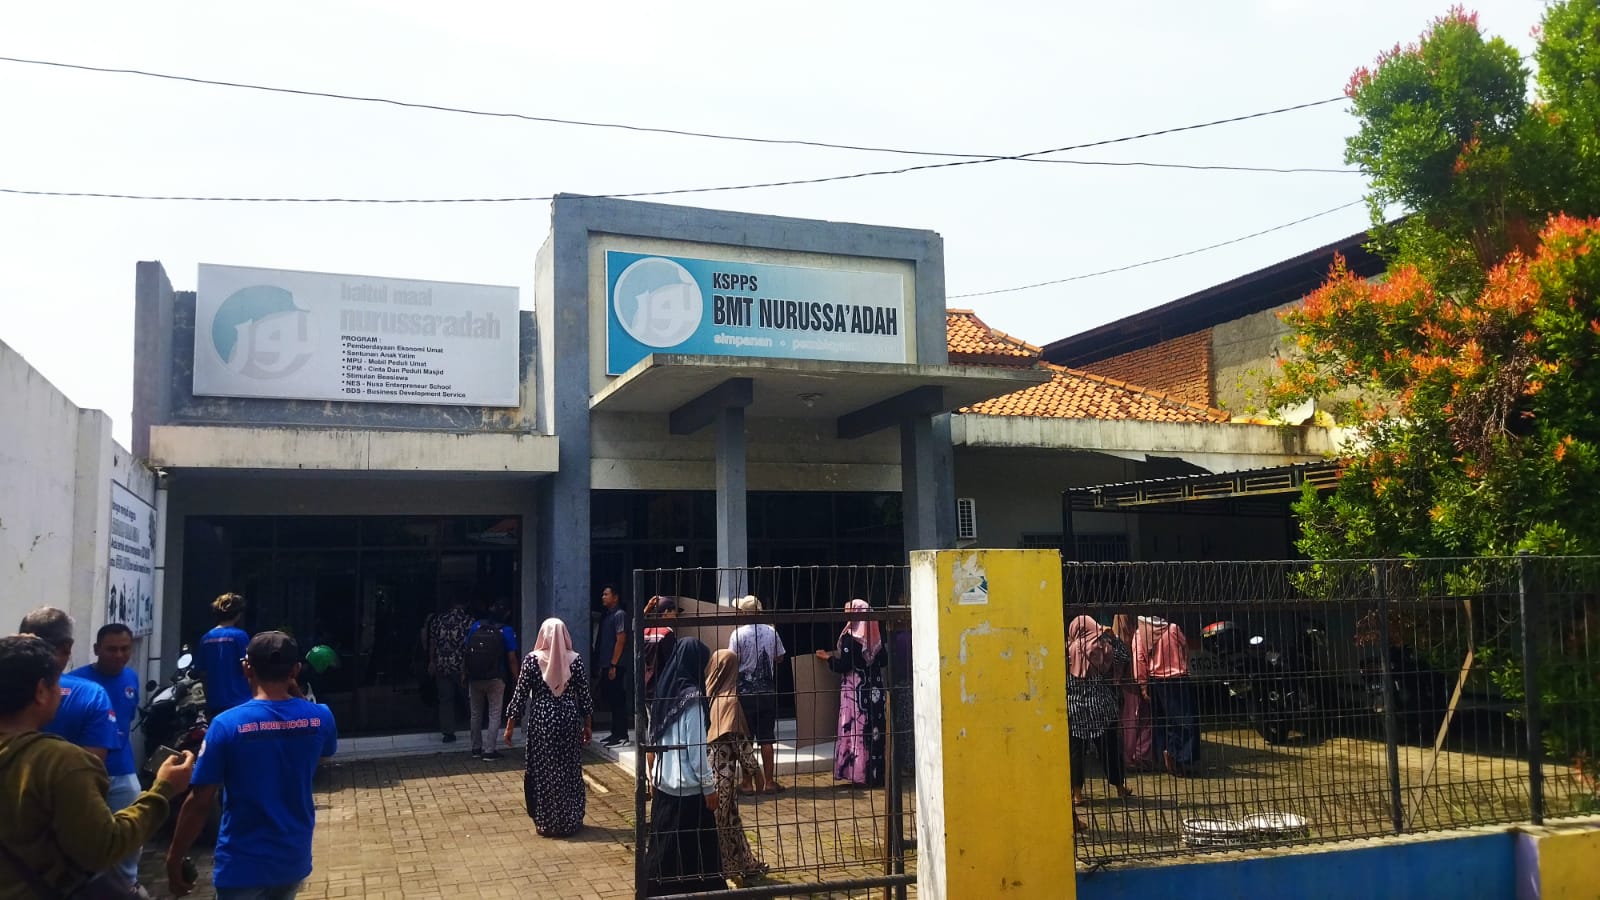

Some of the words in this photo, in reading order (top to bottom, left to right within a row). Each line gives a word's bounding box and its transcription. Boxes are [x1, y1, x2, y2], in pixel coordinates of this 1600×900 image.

[713, 272, 758, 292] KSPPS
[713, 294, 754, 328] BMT
[759, 297, 898, 337] NURUSSA'ADAH
[341, 335, 378, 343] PROGRAM
[368, 365, 386, 373] Cinta
